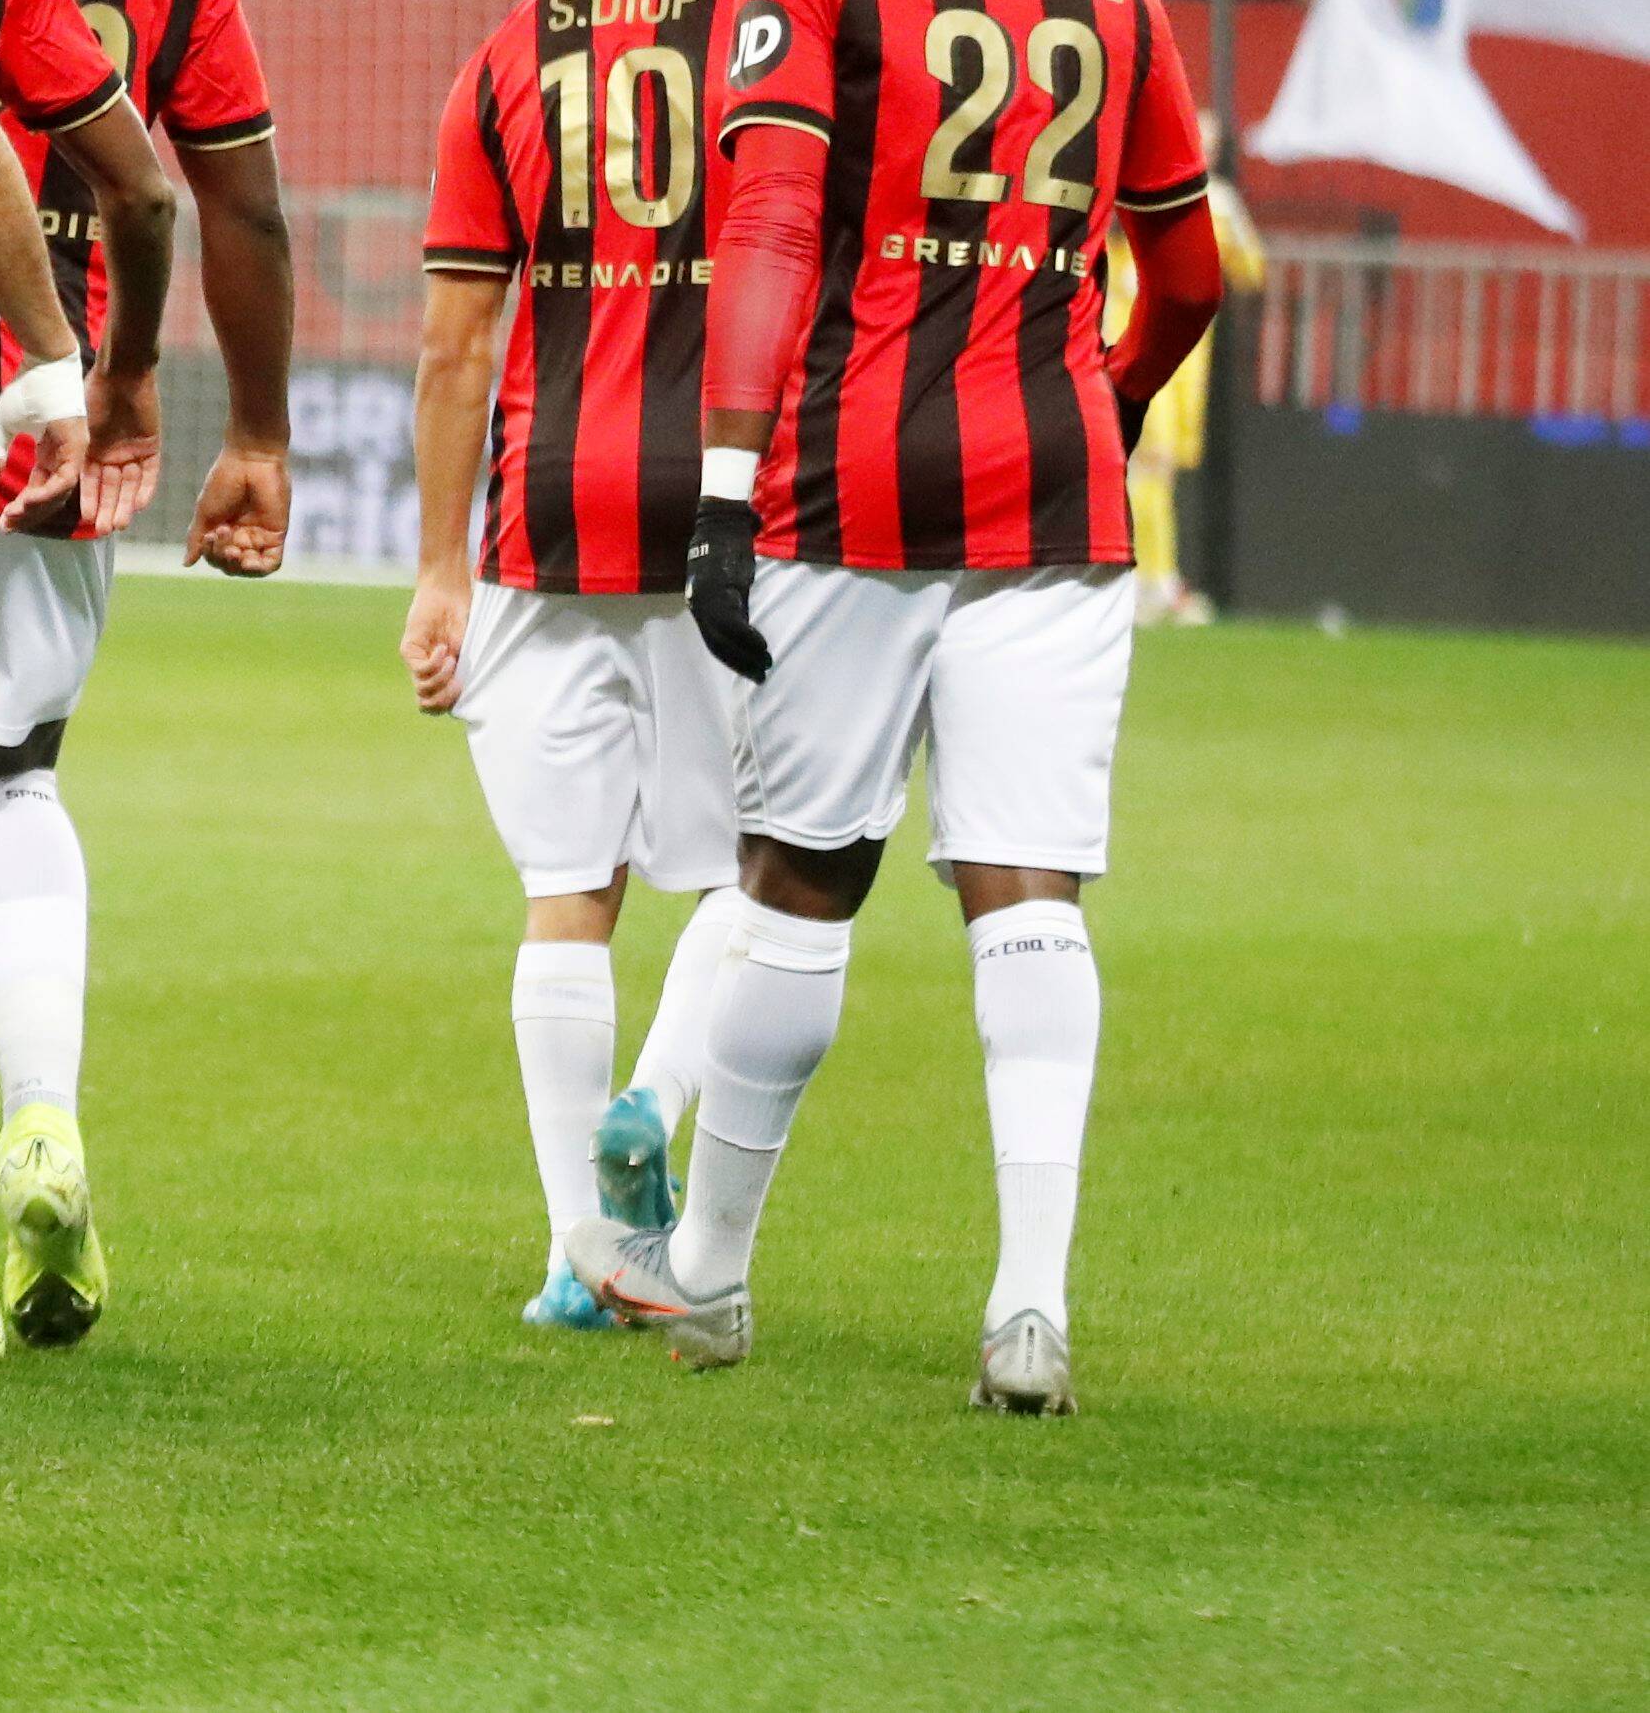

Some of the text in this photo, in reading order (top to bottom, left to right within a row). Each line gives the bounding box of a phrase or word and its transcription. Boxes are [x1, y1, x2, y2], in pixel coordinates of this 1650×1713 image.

[730, 15, 782, 79] JD
[540, 46, 698, 229] 10
[919, 9, 1104, 214] 22
[530, 258, 715, 288] RENADIE
[880, 234, 1088, 278] GRENAIE
